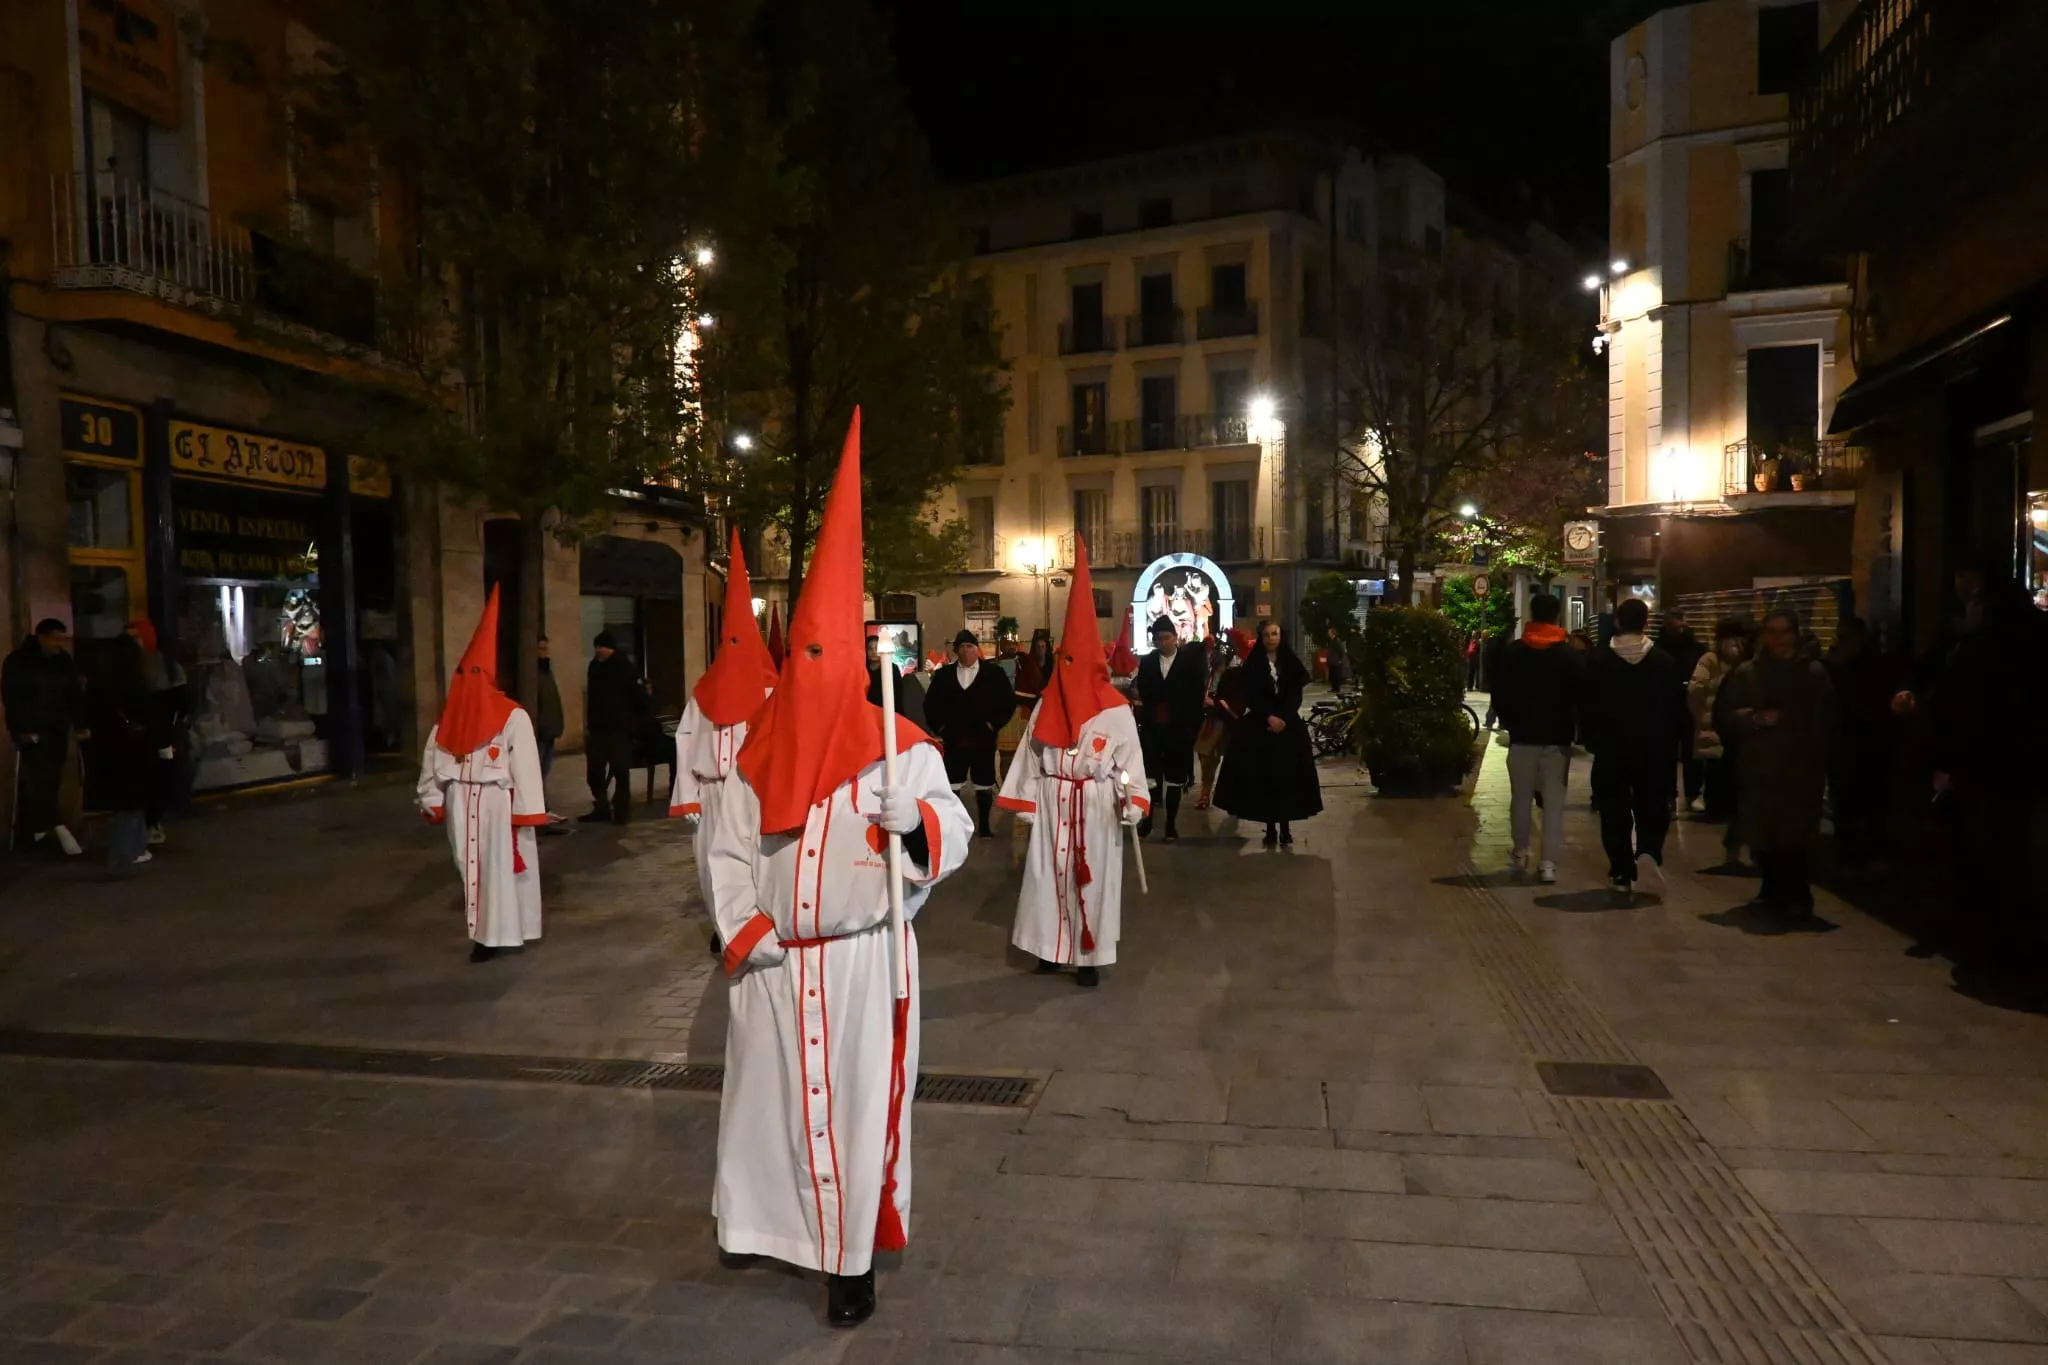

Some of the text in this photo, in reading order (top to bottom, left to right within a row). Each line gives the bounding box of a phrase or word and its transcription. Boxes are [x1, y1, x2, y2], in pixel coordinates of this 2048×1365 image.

[81, 412, 112, 446] 30
[175, 429, 316, 479] EL ARCON
[178, 507, 309, 540] VENTA ESPECIAL
